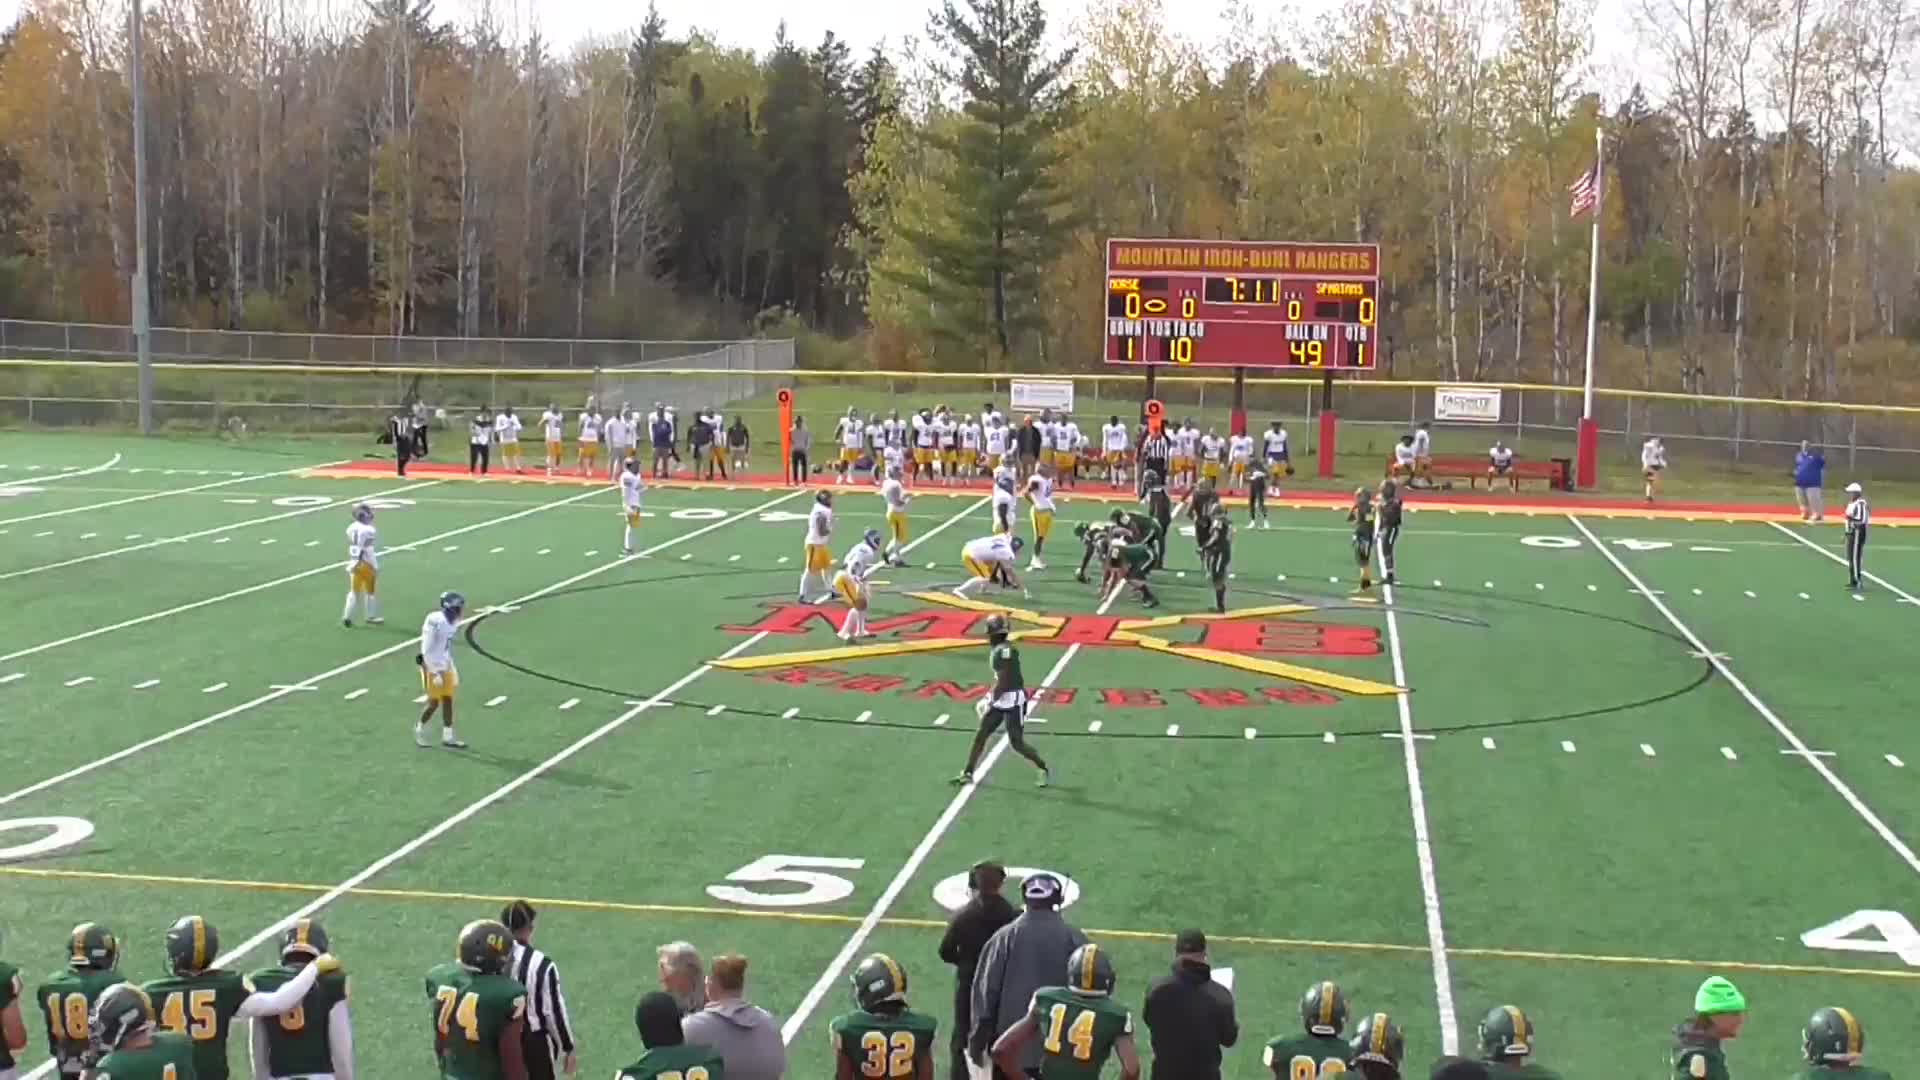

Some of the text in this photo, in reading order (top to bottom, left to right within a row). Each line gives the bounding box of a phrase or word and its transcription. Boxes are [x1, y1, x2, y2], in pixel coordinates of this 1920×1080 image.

[1116, 247, 1200, 266] MOUNTAIN
[1295, 251, 1370, 270] RANGERS
[1225, 277, 1278, 302] 7:11
[1126, 292, 1140, 319] 0
[1182, 298, 1195, 318] 0
[1288, 300, 1301, 320] 0
[1359, 298, 1375, 323] 0
[1109, 320, 1142, 337] DOWN
[1285, 323, 1328, 341] BALL ON
[1127, 337, 1134, 360] 1
[1170, 337, 1192, 363] 10
[1289, 340, 1322, 366] 49
[1358, 342, 1365, 366] 1
[47, 992, 88, 1040] 18
[161, 989, 217, 1040] 45
[437, 985, 479, 1041] 74
[1044, 1002, 1097, 1061] 14
[860, 1031, 915, 1079] 32
